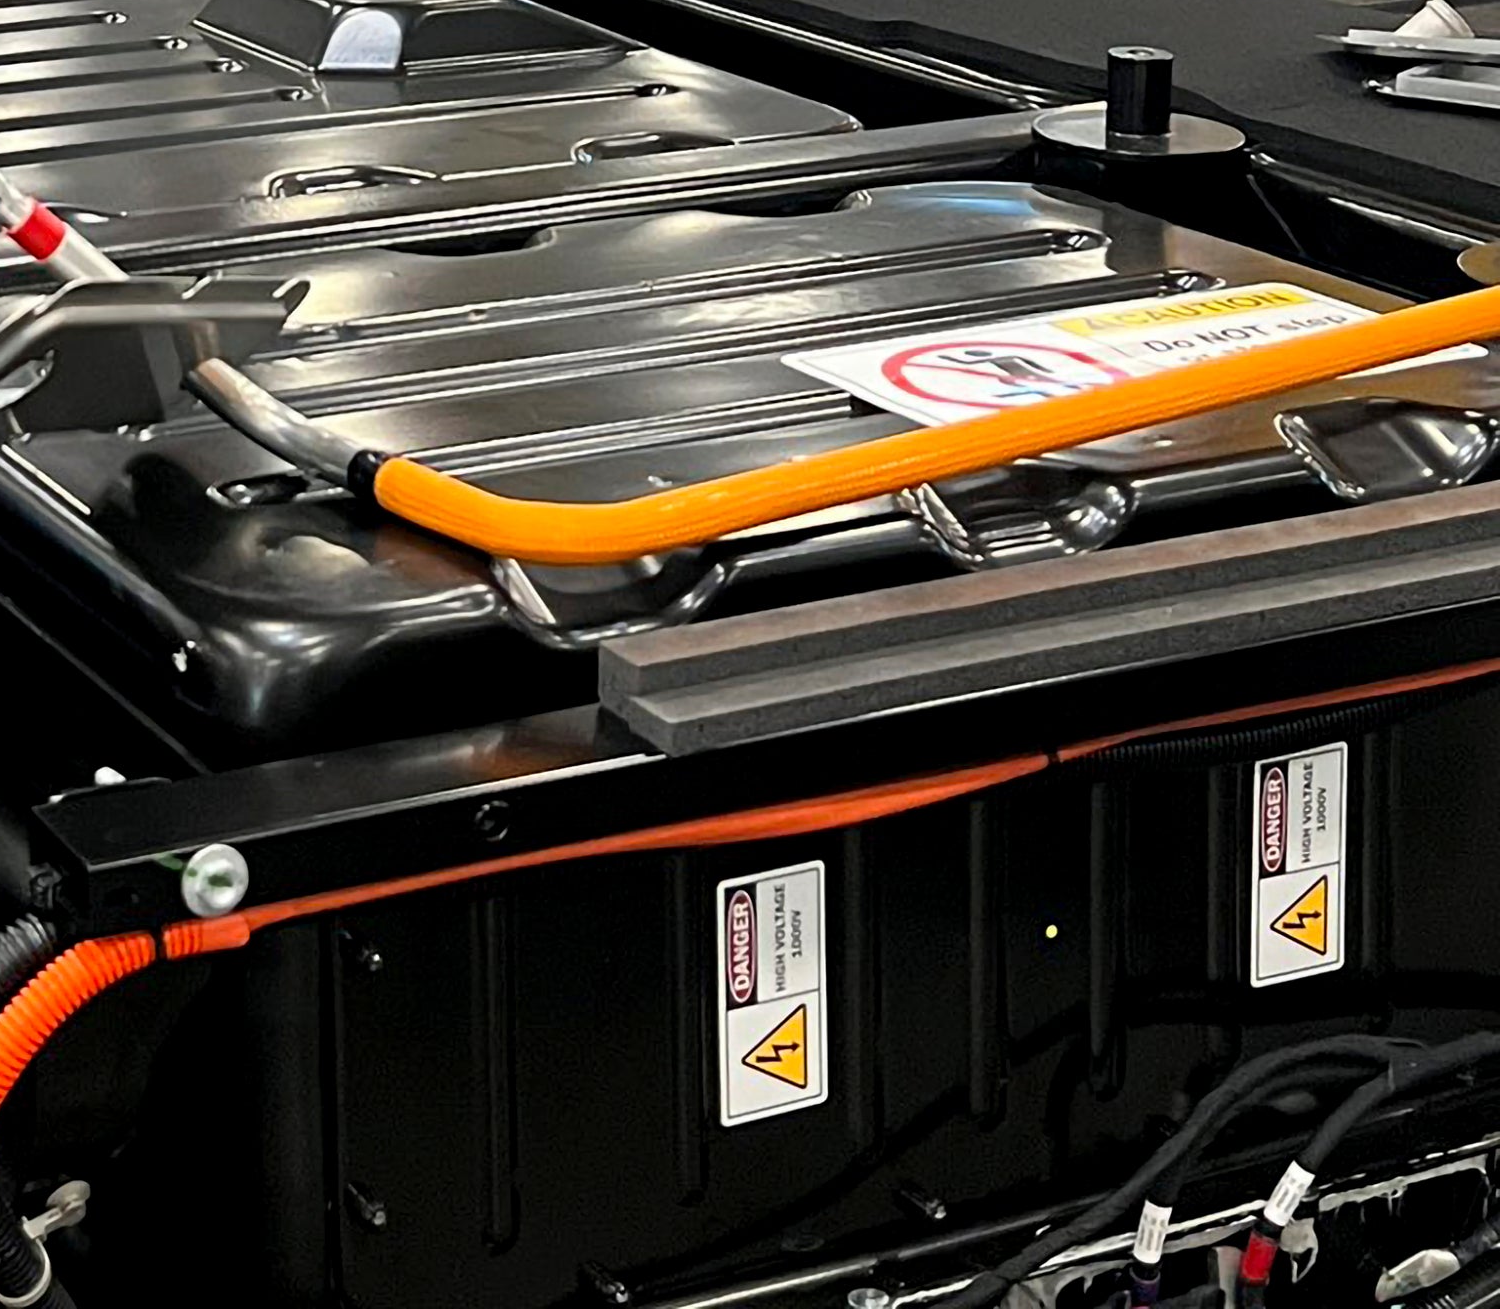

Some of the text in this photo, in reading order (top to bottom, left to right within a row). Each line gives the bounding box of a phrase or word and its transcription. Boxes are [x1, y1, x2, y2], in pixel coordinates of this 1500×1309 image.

[1117, 290, 1290, 327] CAUTION
[1143, 338, 1195, 353] Do
[1195, 324, 1271, 343] NOT
[1265, 778, 1282, 861] DANGER
[1301, 761, 1314, 864] HIGH VOLTAGE
[1316, 786, 1328, 832] 1000V
[732, 901, 750, 991] DANGER
[773, 883, 787, 993] HIGH VOLTAGE
[790, 909, 803, 958] 1000V
